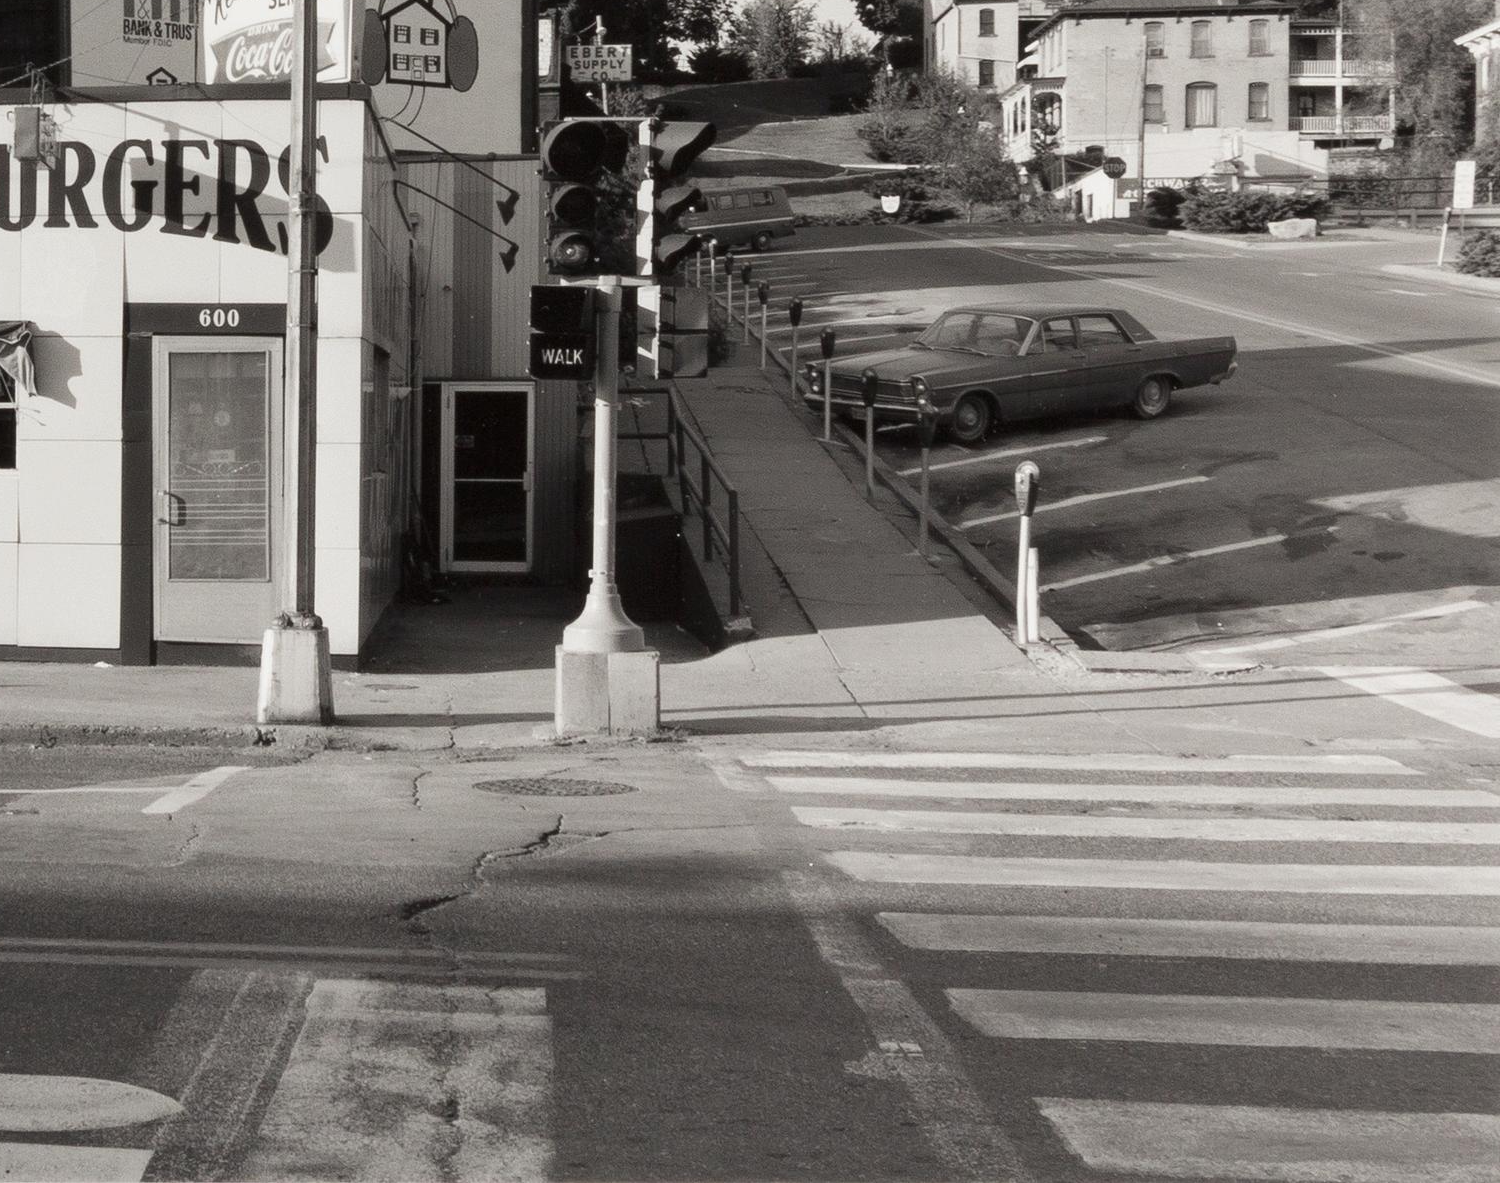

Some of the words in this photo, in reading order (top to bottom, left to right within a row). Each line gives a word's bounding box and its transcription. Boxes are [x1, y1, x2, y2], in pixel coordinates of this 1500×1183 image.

[123, 19, 152, 38] BANK
[154, 21, 163, 38] &
[247, 22, 280, 37] DRINK
[153, 38, 173, 48] FDIC
[570, 46, 628, 59] EBERT
[574, 59, 625, 70] SUPPLY
[591, 71, 611, 82] CO.
[1104, 163, 1126, 174] STOP
[199, 309, 240, 329] 600
[542, 348, 583, 365] WALK
